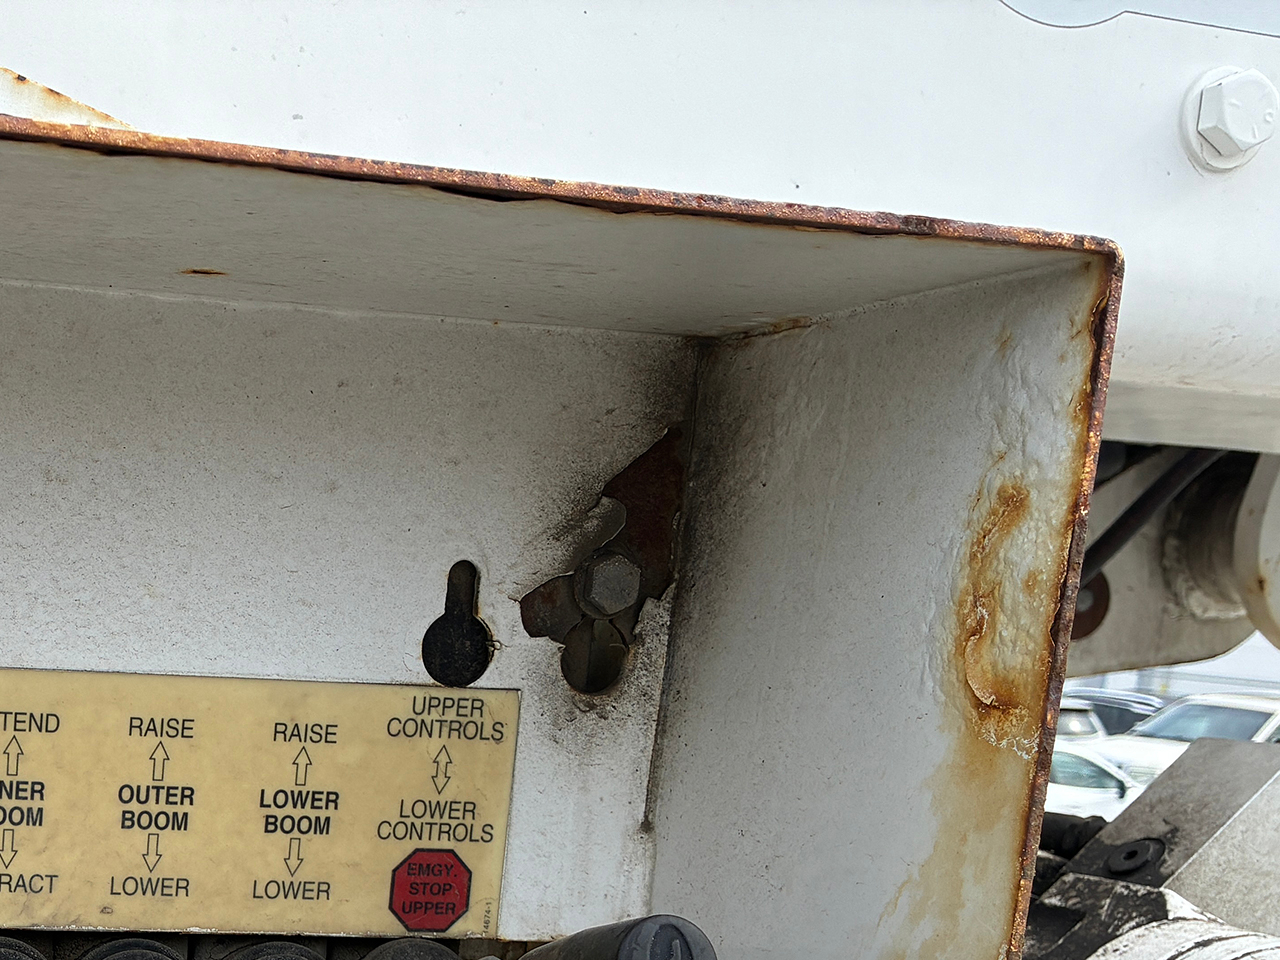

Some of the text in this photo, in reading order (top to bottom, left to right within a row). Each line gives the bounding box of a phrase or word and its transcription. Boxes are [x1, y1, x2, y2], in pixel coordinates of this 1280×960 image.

[412, 697, 484, 718] UPPER
[128, 717, 195, 739] RAISE
[273, 723, 338, 744] RAISE
[387, 718, 504, 742] CONTROLS
[118, 784, 195, 806] OUTER
[259, 789, 339, 811] LOWER
[399, 799, 476, 821] LOWER
[121, 810, 188, 832] BOOM
[264, 814, 330, 835] BOOM
[377, 821, 494, 843] CONTROLS
[407, 862, 457, 878] EMGY.
[110, 876, 189, 897] LOWER
[253, 880, 330, 901] LOWER
[409, 880, 452, 896] STOP
[402, 900, 456, 916] UPPER
